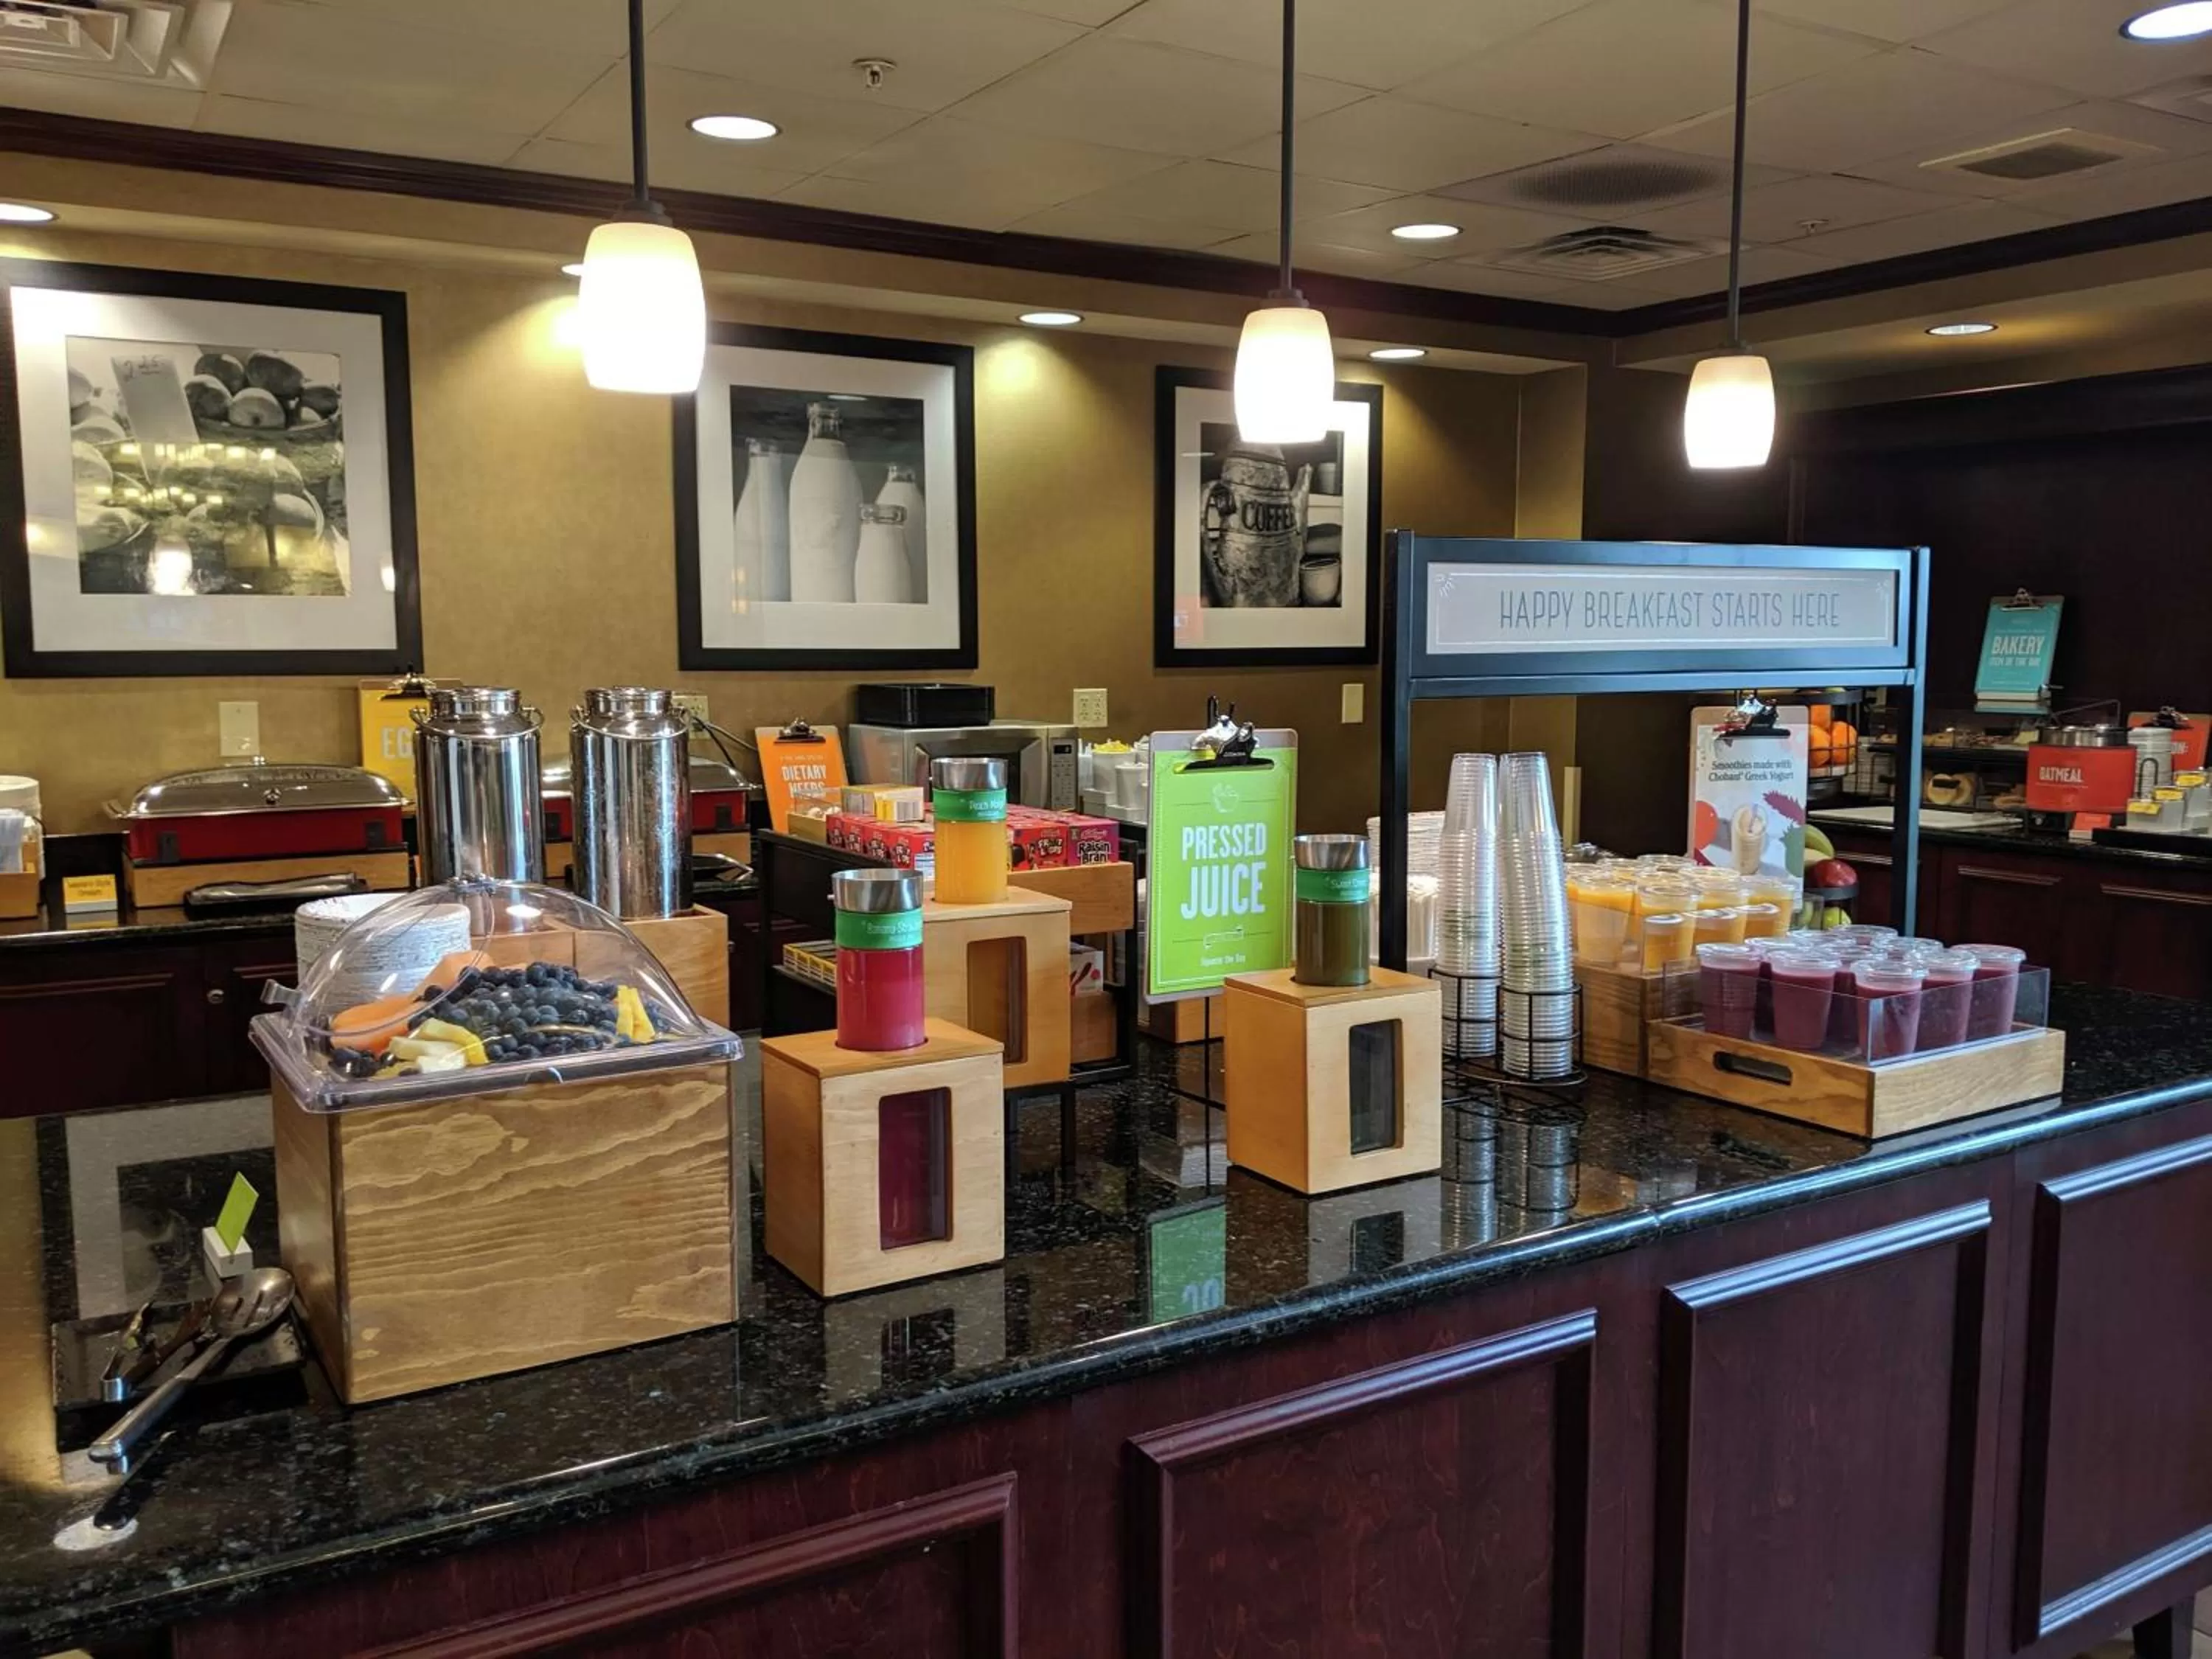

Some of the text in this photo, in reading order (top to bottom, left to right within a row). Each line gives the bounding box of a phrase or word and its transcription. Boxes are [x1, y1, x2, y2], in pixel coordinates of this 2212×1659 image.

[1500, 590, 1840, 629] HAPPY BREAKFAST STARTS HERE
[1992, 635, 2045, 655] BAKERY
[781, 765, 827, 782] DIETARY
[1711, 759, 1792, 771] Smoothies made with
[1745, 771, 1767, 781] Greek
[1770, 771, 1793, 782] Yogurt
[2039, 766, 2083, 783] OATMEAL
[788, 781, 826, 799] NEEDS
[1077, 840, 1111, 854] Raisin
[1181, 822, 1267, 861] PRESSED
[1080, 852, 1109, 864] Bran
[1180, 861, 1267, 919] JUICE
